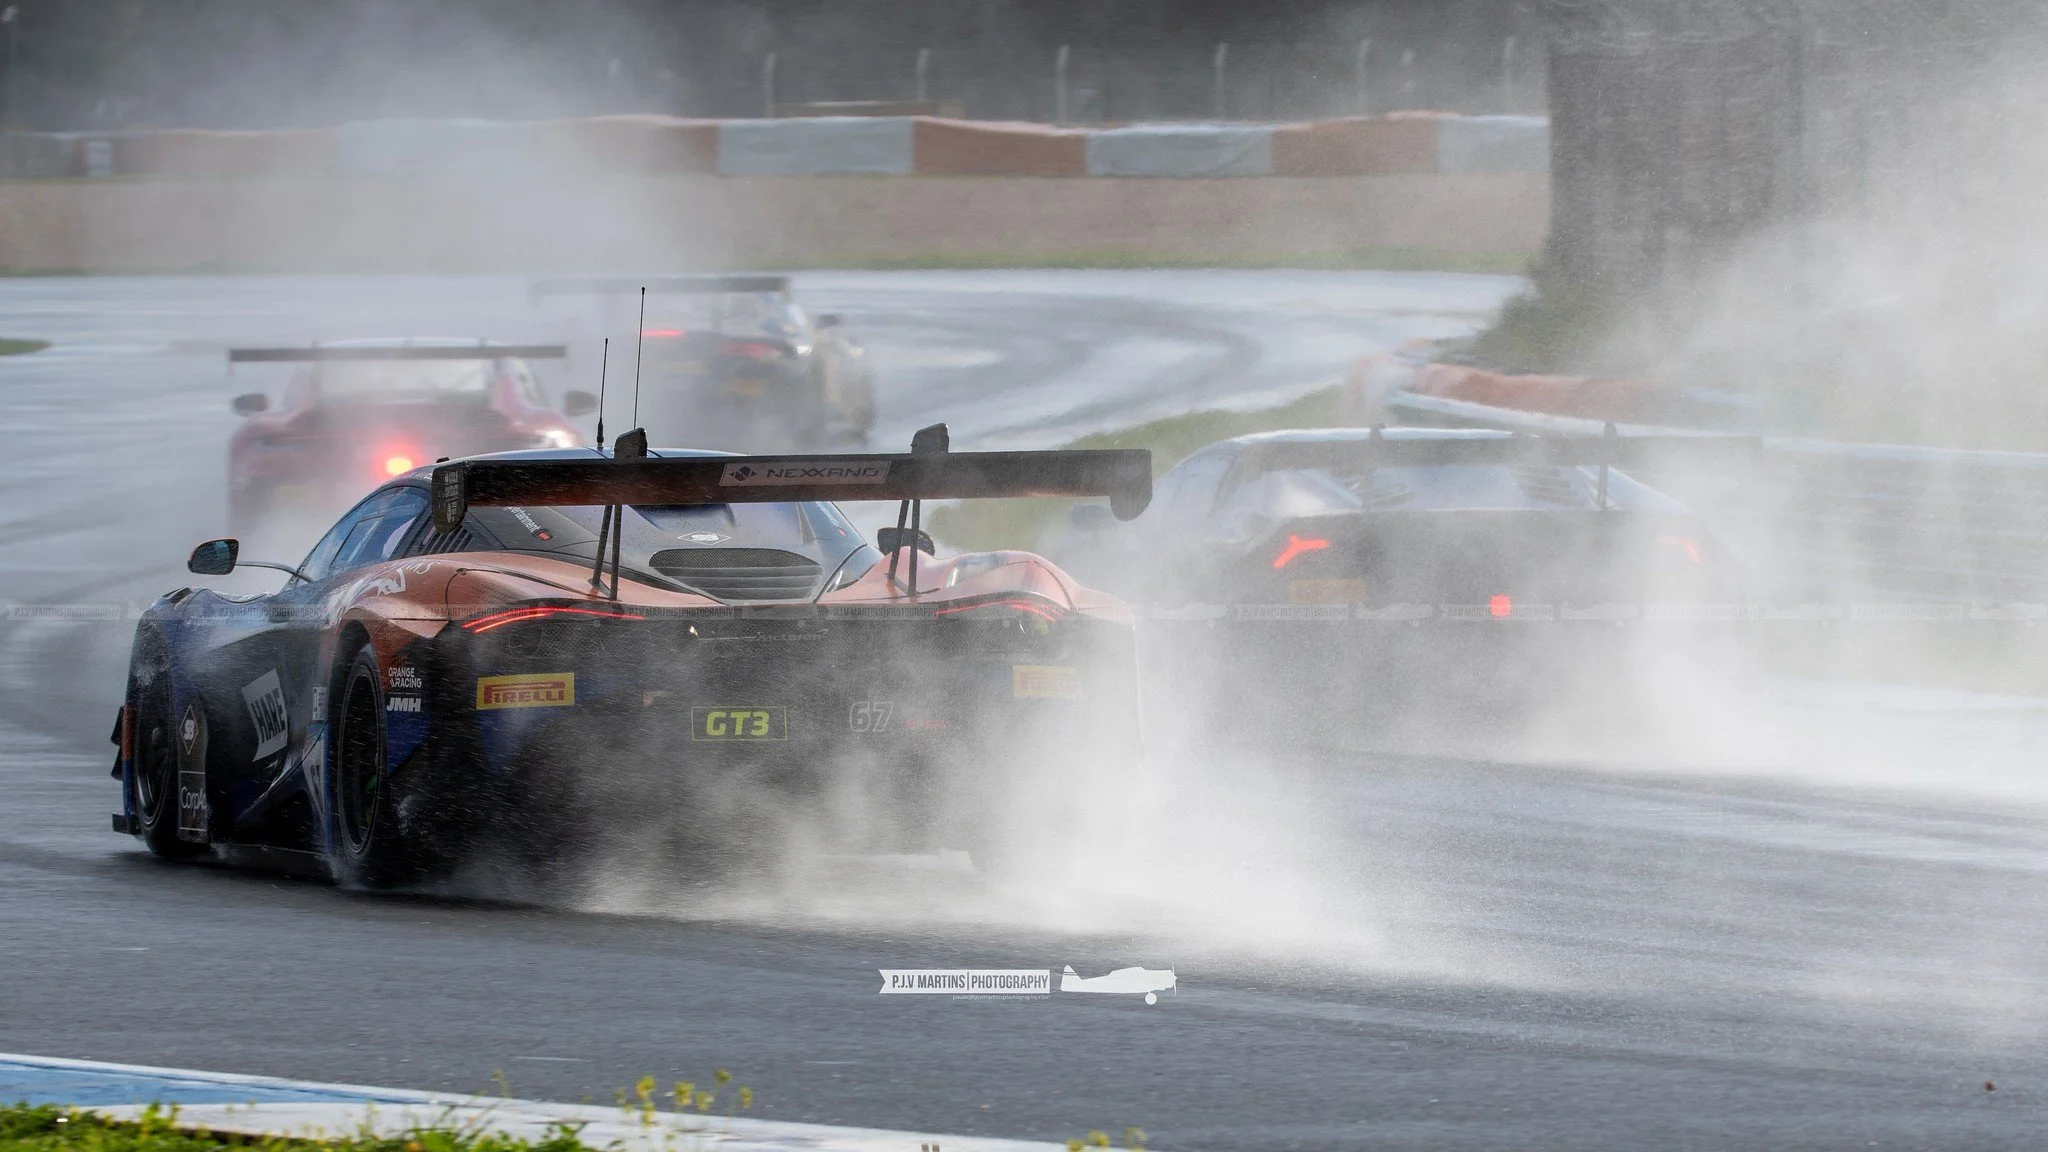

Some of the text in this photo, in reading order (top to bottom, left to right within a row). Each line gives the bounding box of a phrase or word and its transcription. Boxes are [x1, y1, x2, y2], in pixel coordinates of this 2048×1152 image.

[388, 666, 415, 678] ORANGE
[386, 697, 422, 712] JMH
[484, 681, 566, 705] PIRELLI
[706, 711, 770, 736] GT3
[849, 701, 894, 732] 67
